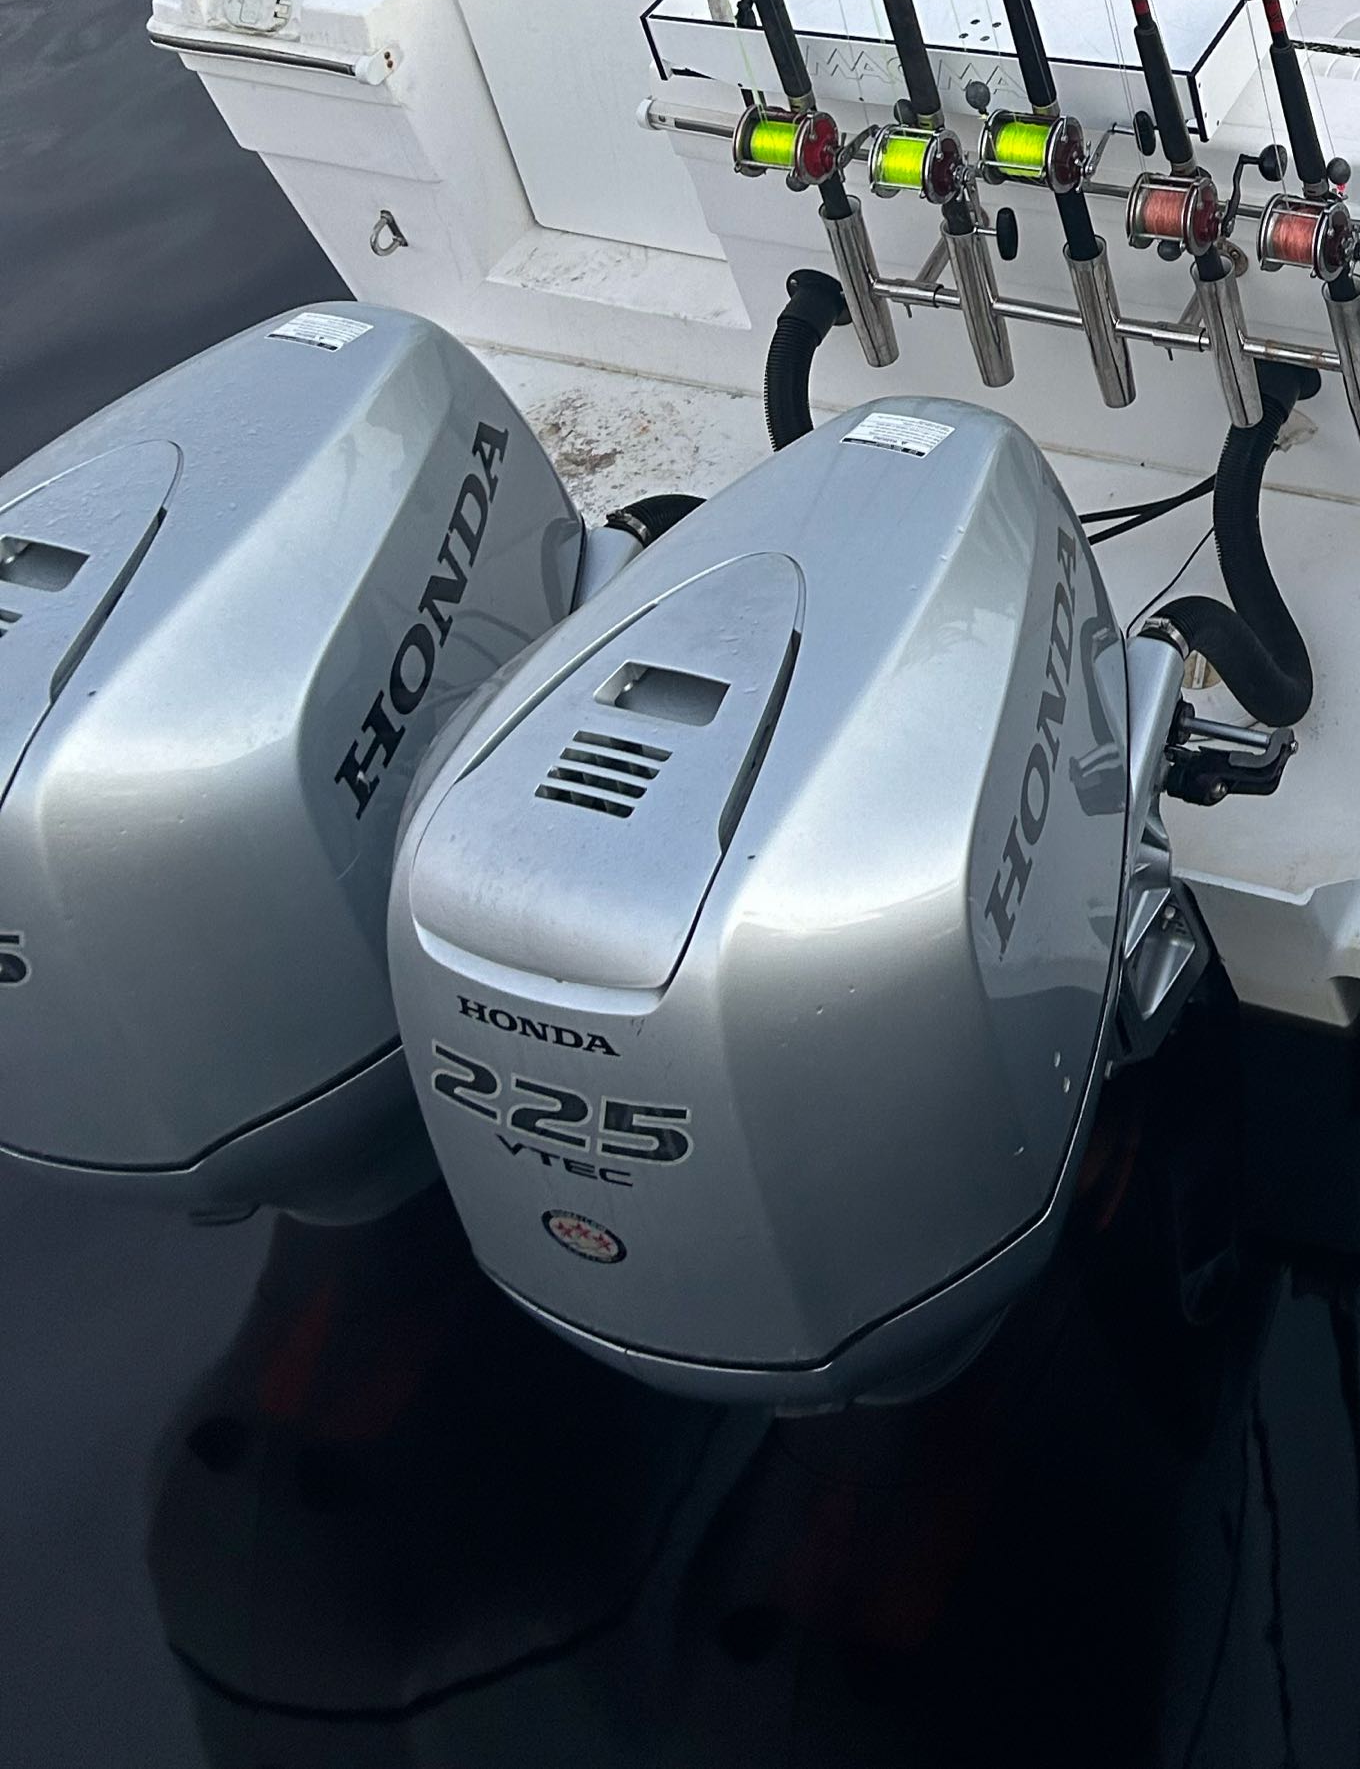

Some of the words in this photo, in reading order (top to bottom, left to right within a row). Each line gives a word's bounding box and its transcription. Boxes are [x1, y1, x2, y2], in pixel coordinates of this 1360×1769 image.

[333, 419, 510, 820] HONDA
[982, 524, 1078, 962] HONDA
[456, 995, 621, 1057] HONDA
[431, 1040, 694, 1167] 225
[495, 1133, 634, 1188] VTEC
